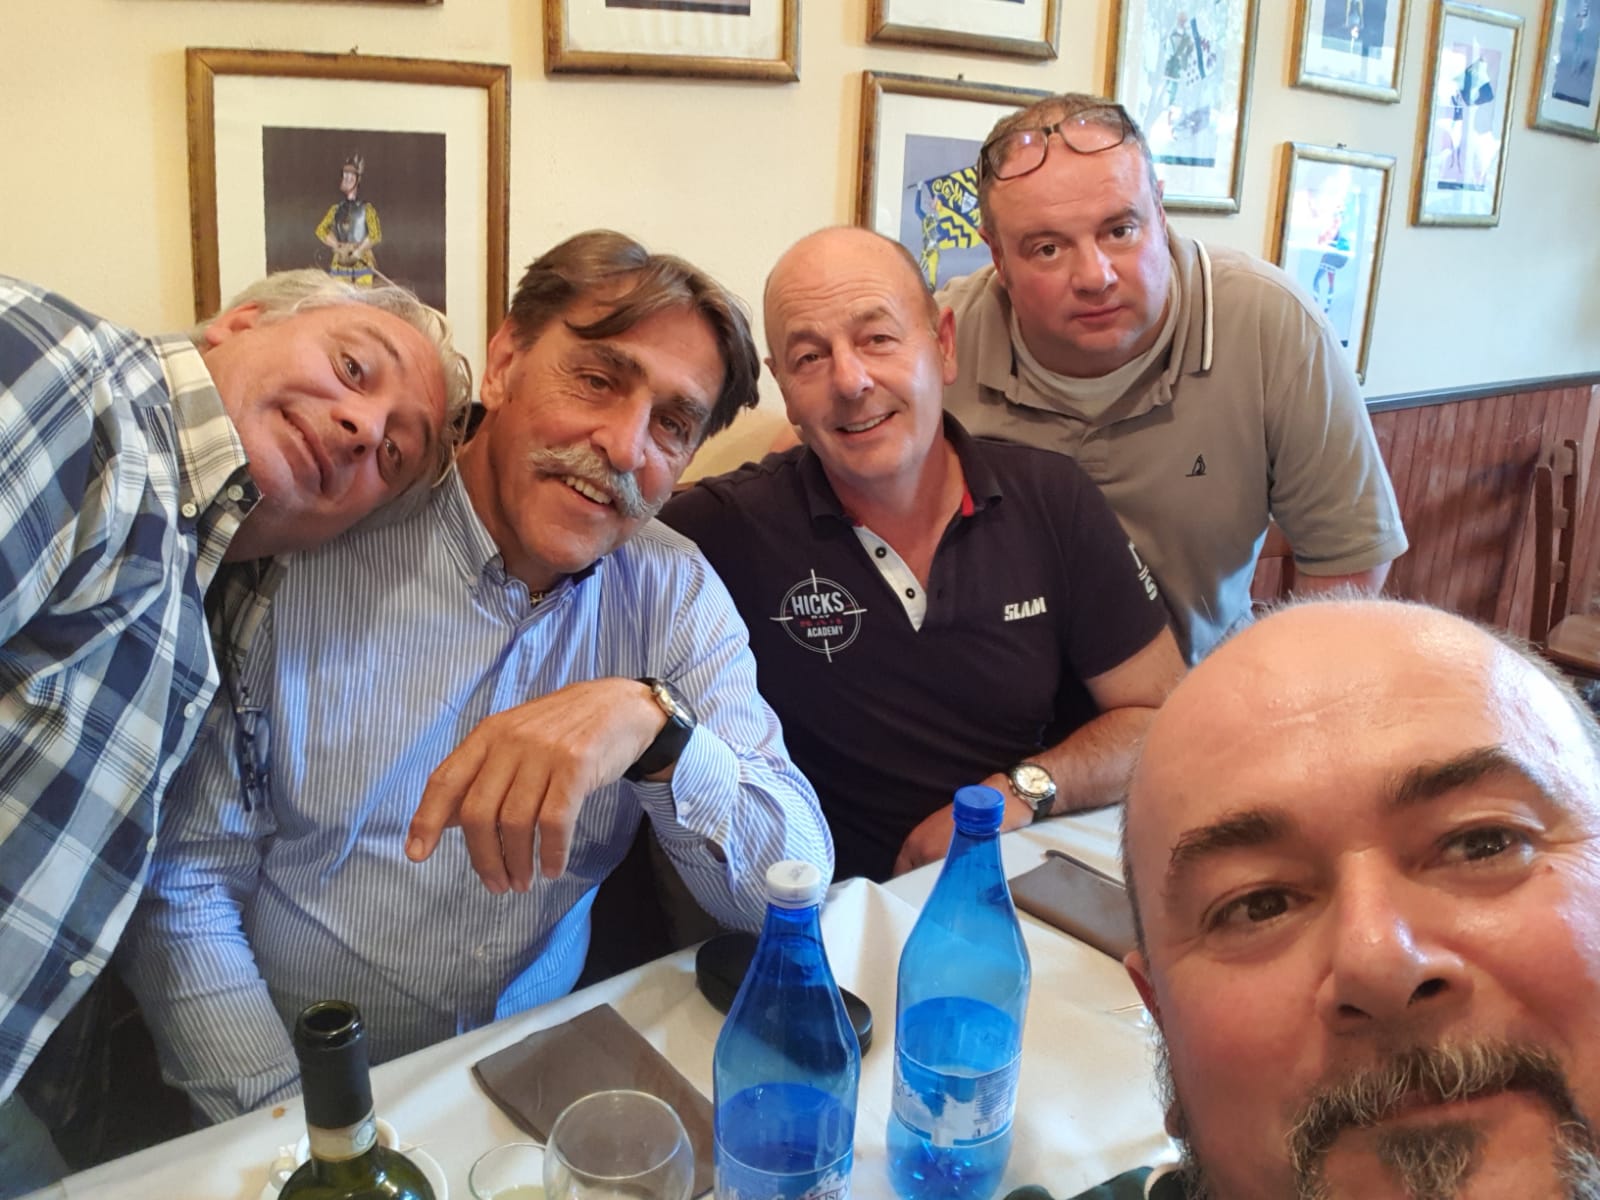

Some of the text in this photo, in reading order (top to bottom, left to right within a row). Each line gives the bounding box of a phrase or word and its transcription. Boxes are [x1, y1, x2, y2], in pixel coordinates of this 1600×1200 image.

[791, 591, 845, 616] HICKS
[1004, 597, 1047, 621] SLAM
[807, 625, 844, 638] ACADEMY
